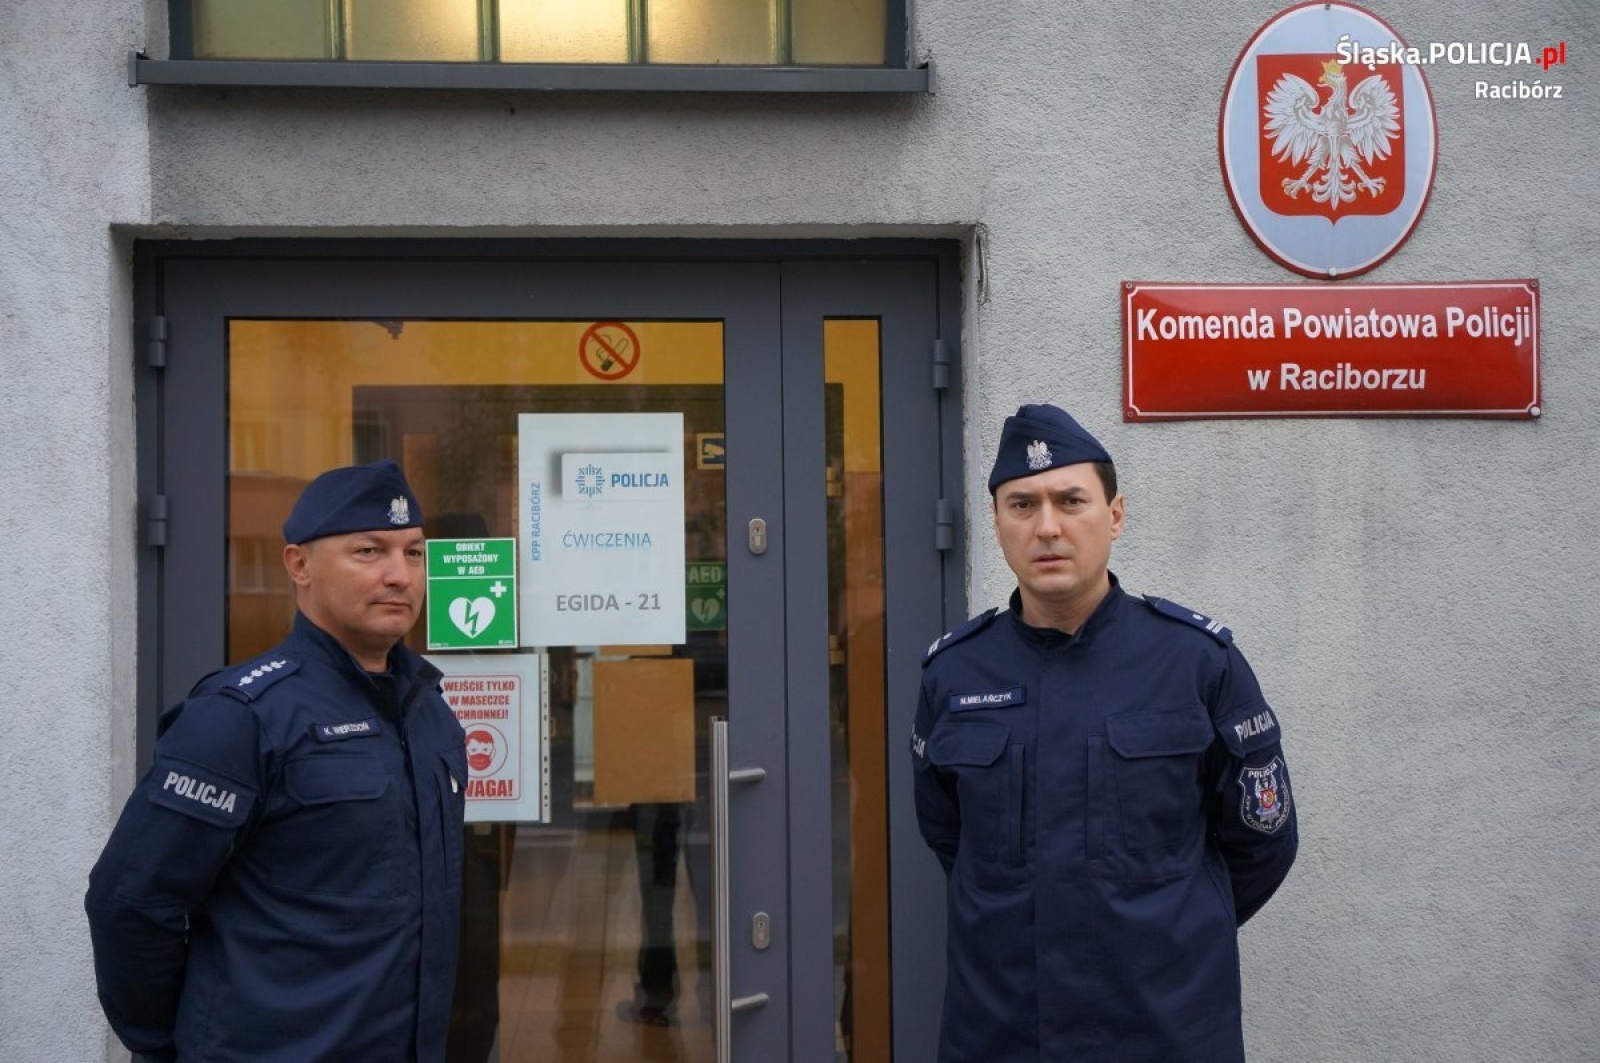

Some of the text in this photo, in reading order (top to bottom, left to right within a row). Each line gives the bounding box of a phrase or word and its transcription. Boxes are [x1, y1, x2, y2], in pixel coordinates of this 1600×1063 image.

[1137, 306, 1530, 346] Komenda Powiatowa Policji
[1247, 363, 1425, 390] w Raciborzu
[611, 473, 669, 488] POLICJA
[528, 482, 541, 561] KPP RACIBÓRZ
[455, 542, 486, 552] OBIEKT
[562, 530, 652, 548] ĆWICZENIA
[443, 552, 499, 564] WYPOSAŻONY
[457, 566, 485, 575] W AED
[689, 566, 722, 583] AED
[556, 594, 620, 611] EGIDA
[638, 594, 662, 610] 21
[444, 680, 515, 691] WEJŚCIE TYLKO
[449, 695, 510, 706] W MASECZCE
[1234, 710, 1275, 743] POLICJA
[162, 771, 237, 813] POLICJA
